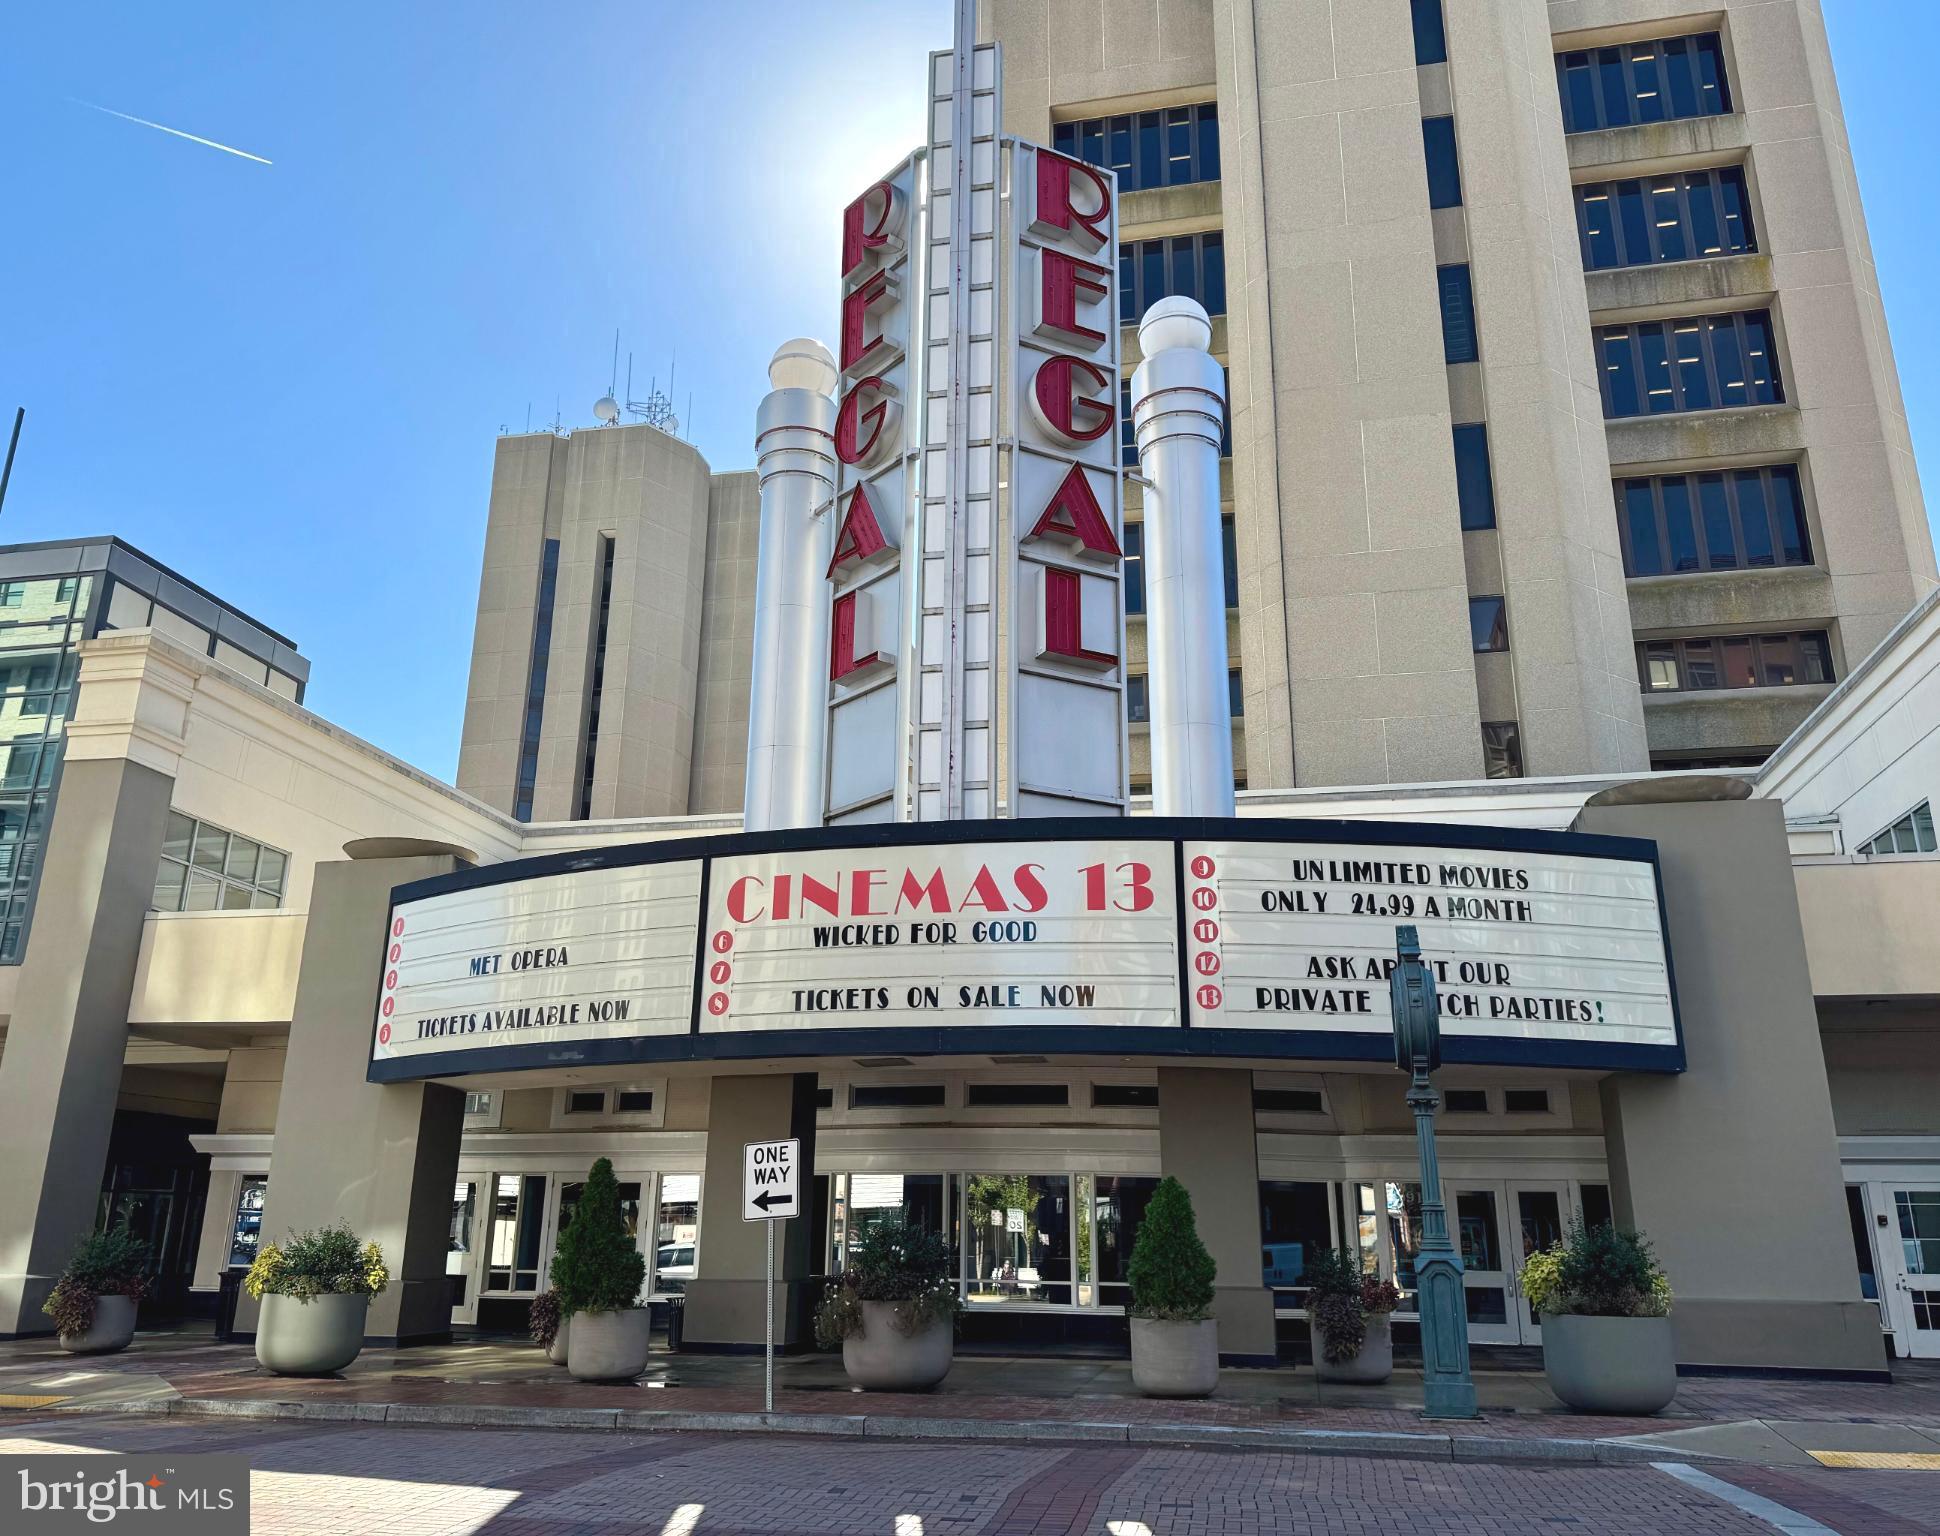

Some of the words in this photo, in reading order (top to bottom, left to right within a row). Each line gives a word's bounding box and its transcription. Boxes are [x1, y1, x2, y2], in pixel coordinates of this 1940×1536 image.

[1025, 147, 1123, 668] REGAL
[825, 180, 900, 683] REGAL
[1292, 859, 1430, 886] UNLIMITED
[1439, 865, 1529, 890] MOVIES
[726, 863, 1049, 924] CINEMAS
[1077, 862, 1155, 912] 13
[1195, 891, 1214, 907] 10
[1261, 891, 1327, 913] ONLY
[1351, 893, 1415, 917] 24.99
[1425, 897, 1441, 918] A
[1448, 896, 1532, 922] MONTH
[814, 921, 900, 948] WICKED
[910, 922, 958, 945] FOR
[972, 920, 1038, 943] GOOD
[1198, 924, 1214, 939] 11
[469, 954, 501, 976] MET
[510, 946, 569, 971] OPERA
[1199, 955, 1217, 972] 12
[1307, 956, 1357, 979] ASK
[1460, 961, 1511, 985] OUR
[792, 987, 889, 1012] TICKETS
[907, 986, 939, 1009] ON
[959, 984, 1020, 1008] SALE
[1041, 985, 1095, 1008] NOW
[1199, 989, 1219, 1006] 13
[1256, 988, 1371, 1014] PRIVATE
[1491, 996, 1605, 1023] PARTIES!
[418, 1013, 477, 1039] TICKETS
[481, 1003, 580, 1031] AVAILABLE
[588, 999, 630, 1022] NOW
[754, 1145, 789, 1165] ONE
[754, 1165, 791, 1185] WAY
